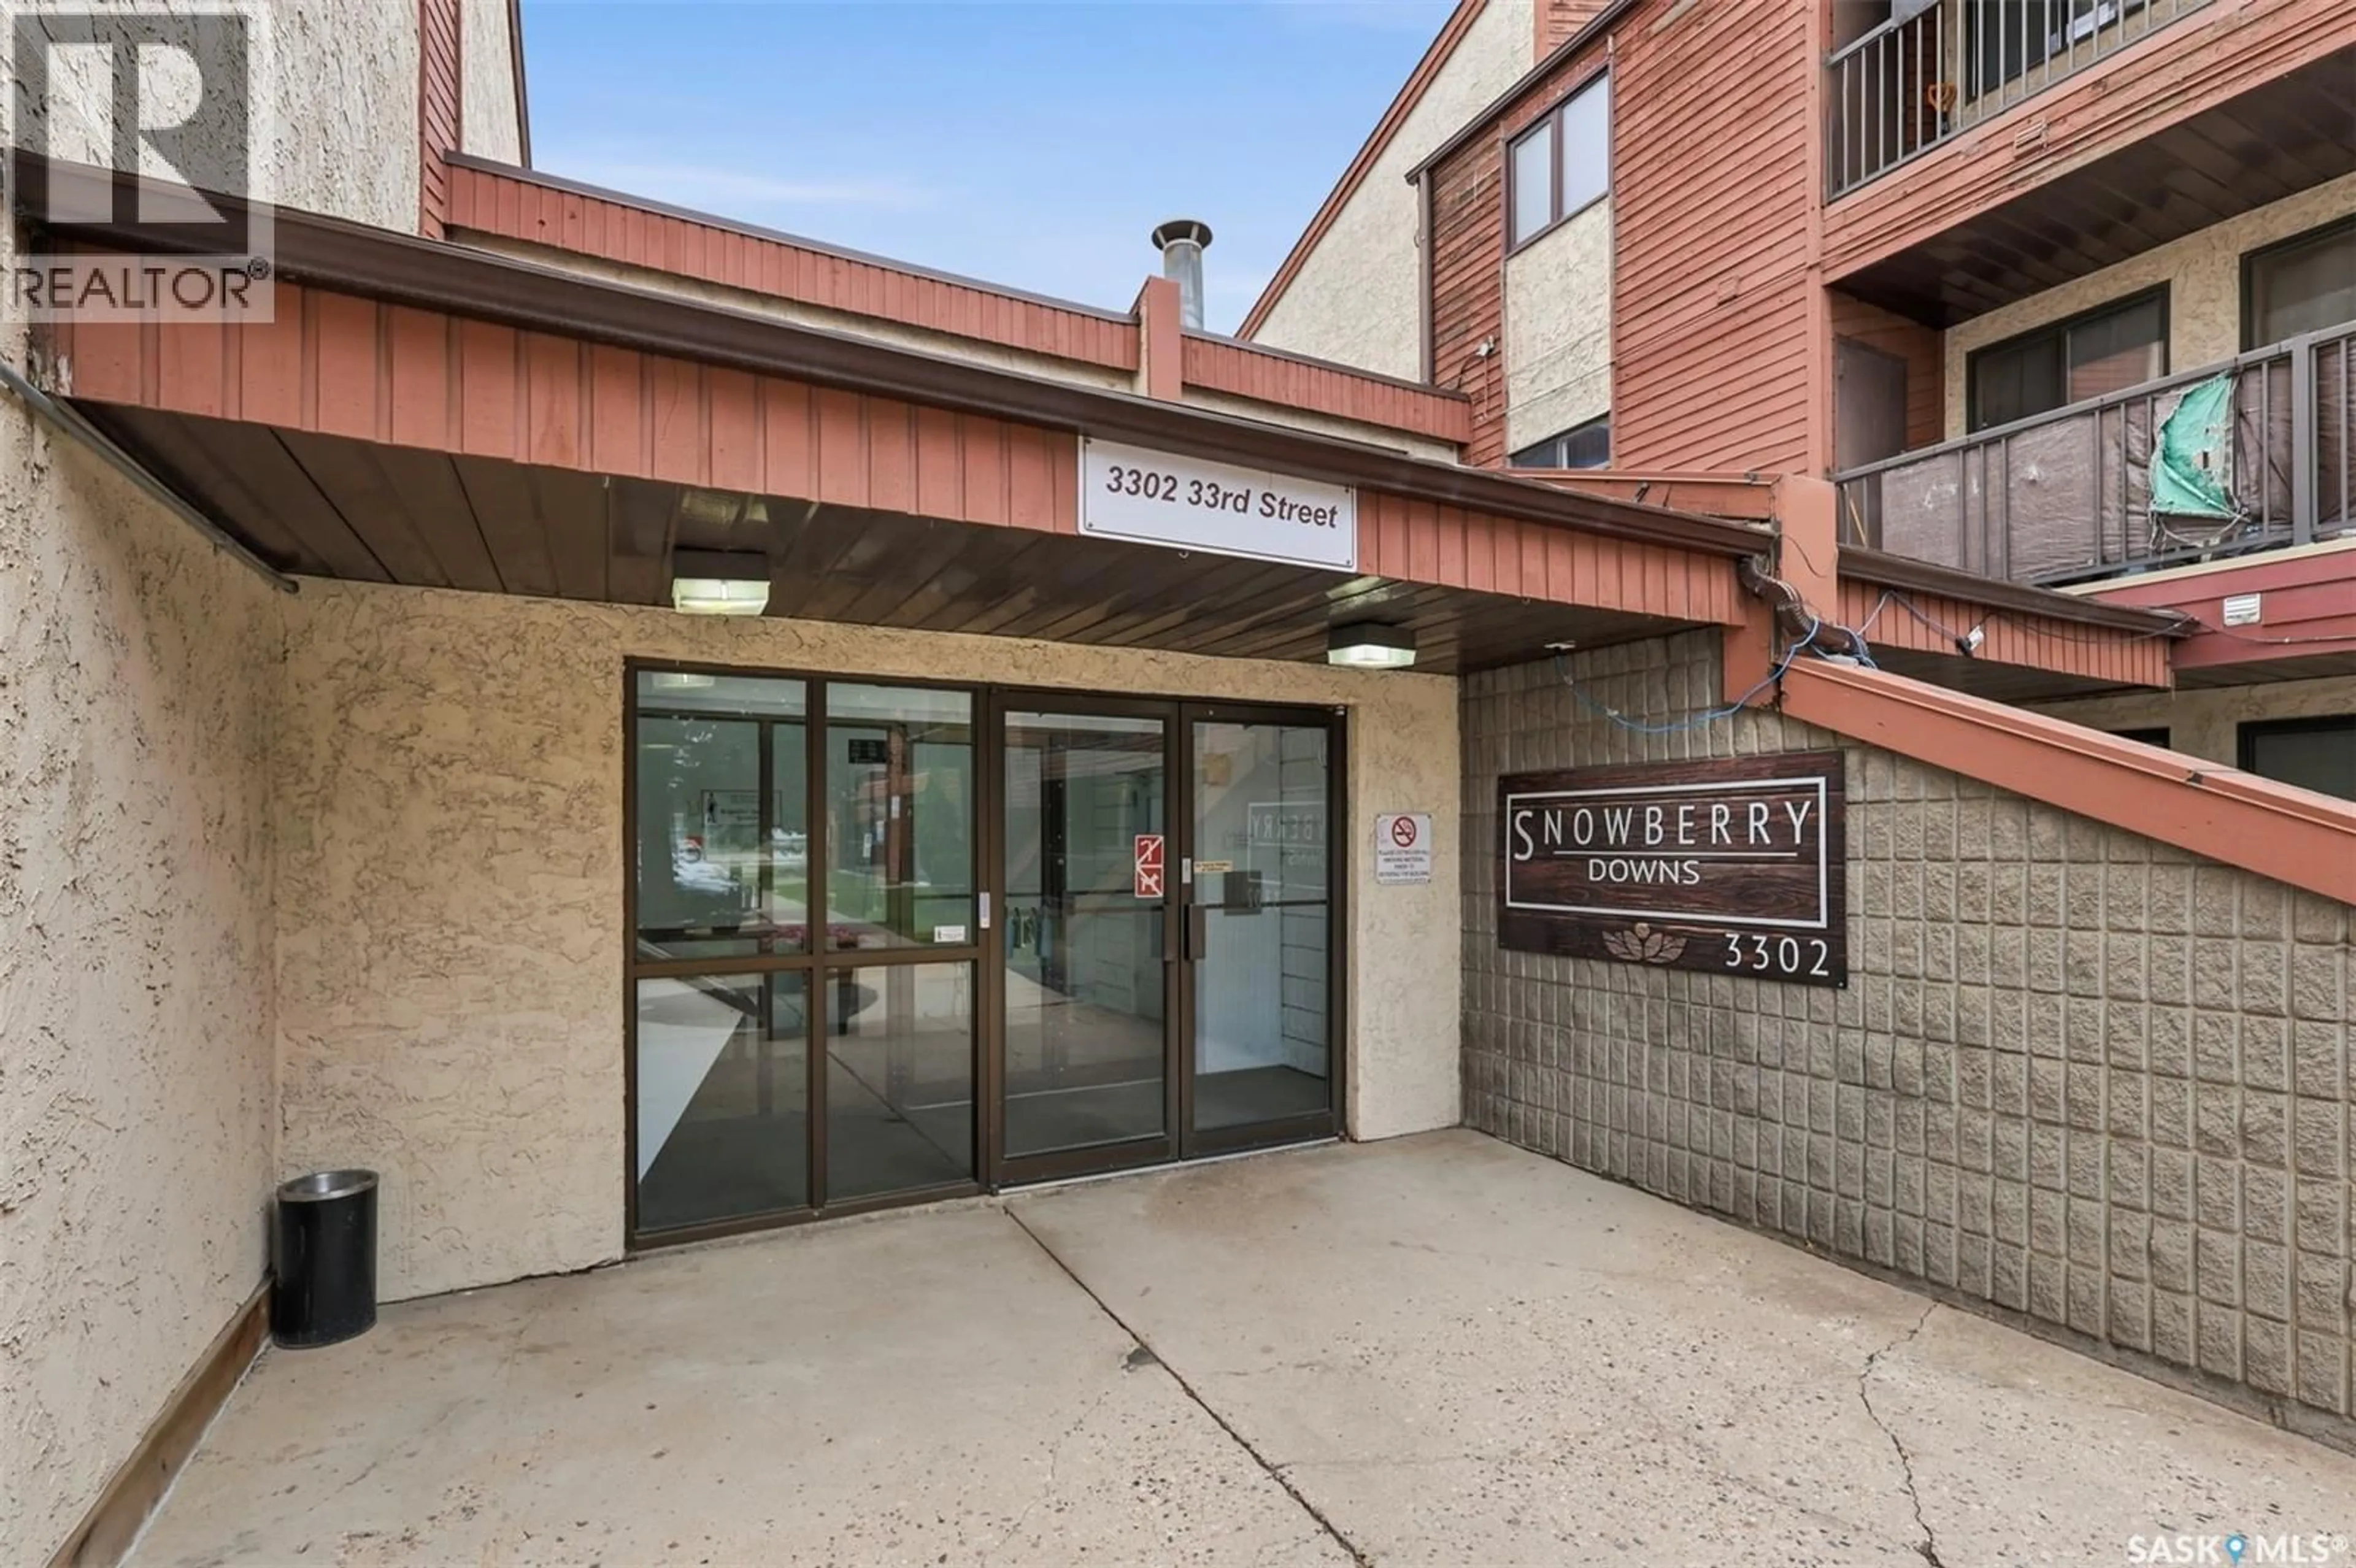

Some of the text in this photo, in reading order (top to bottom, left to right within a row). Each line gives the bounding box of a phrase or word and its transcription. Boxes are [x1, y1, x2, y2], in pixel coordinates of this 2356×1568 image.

[1106, 466, 1339, 528] 3302 33rd Street
[1514, 801, 1812, 860] SNOWBERRY
[1587, 858, 1701, 885] DOWNS
[1724, 932, 1830, 976] 3302
